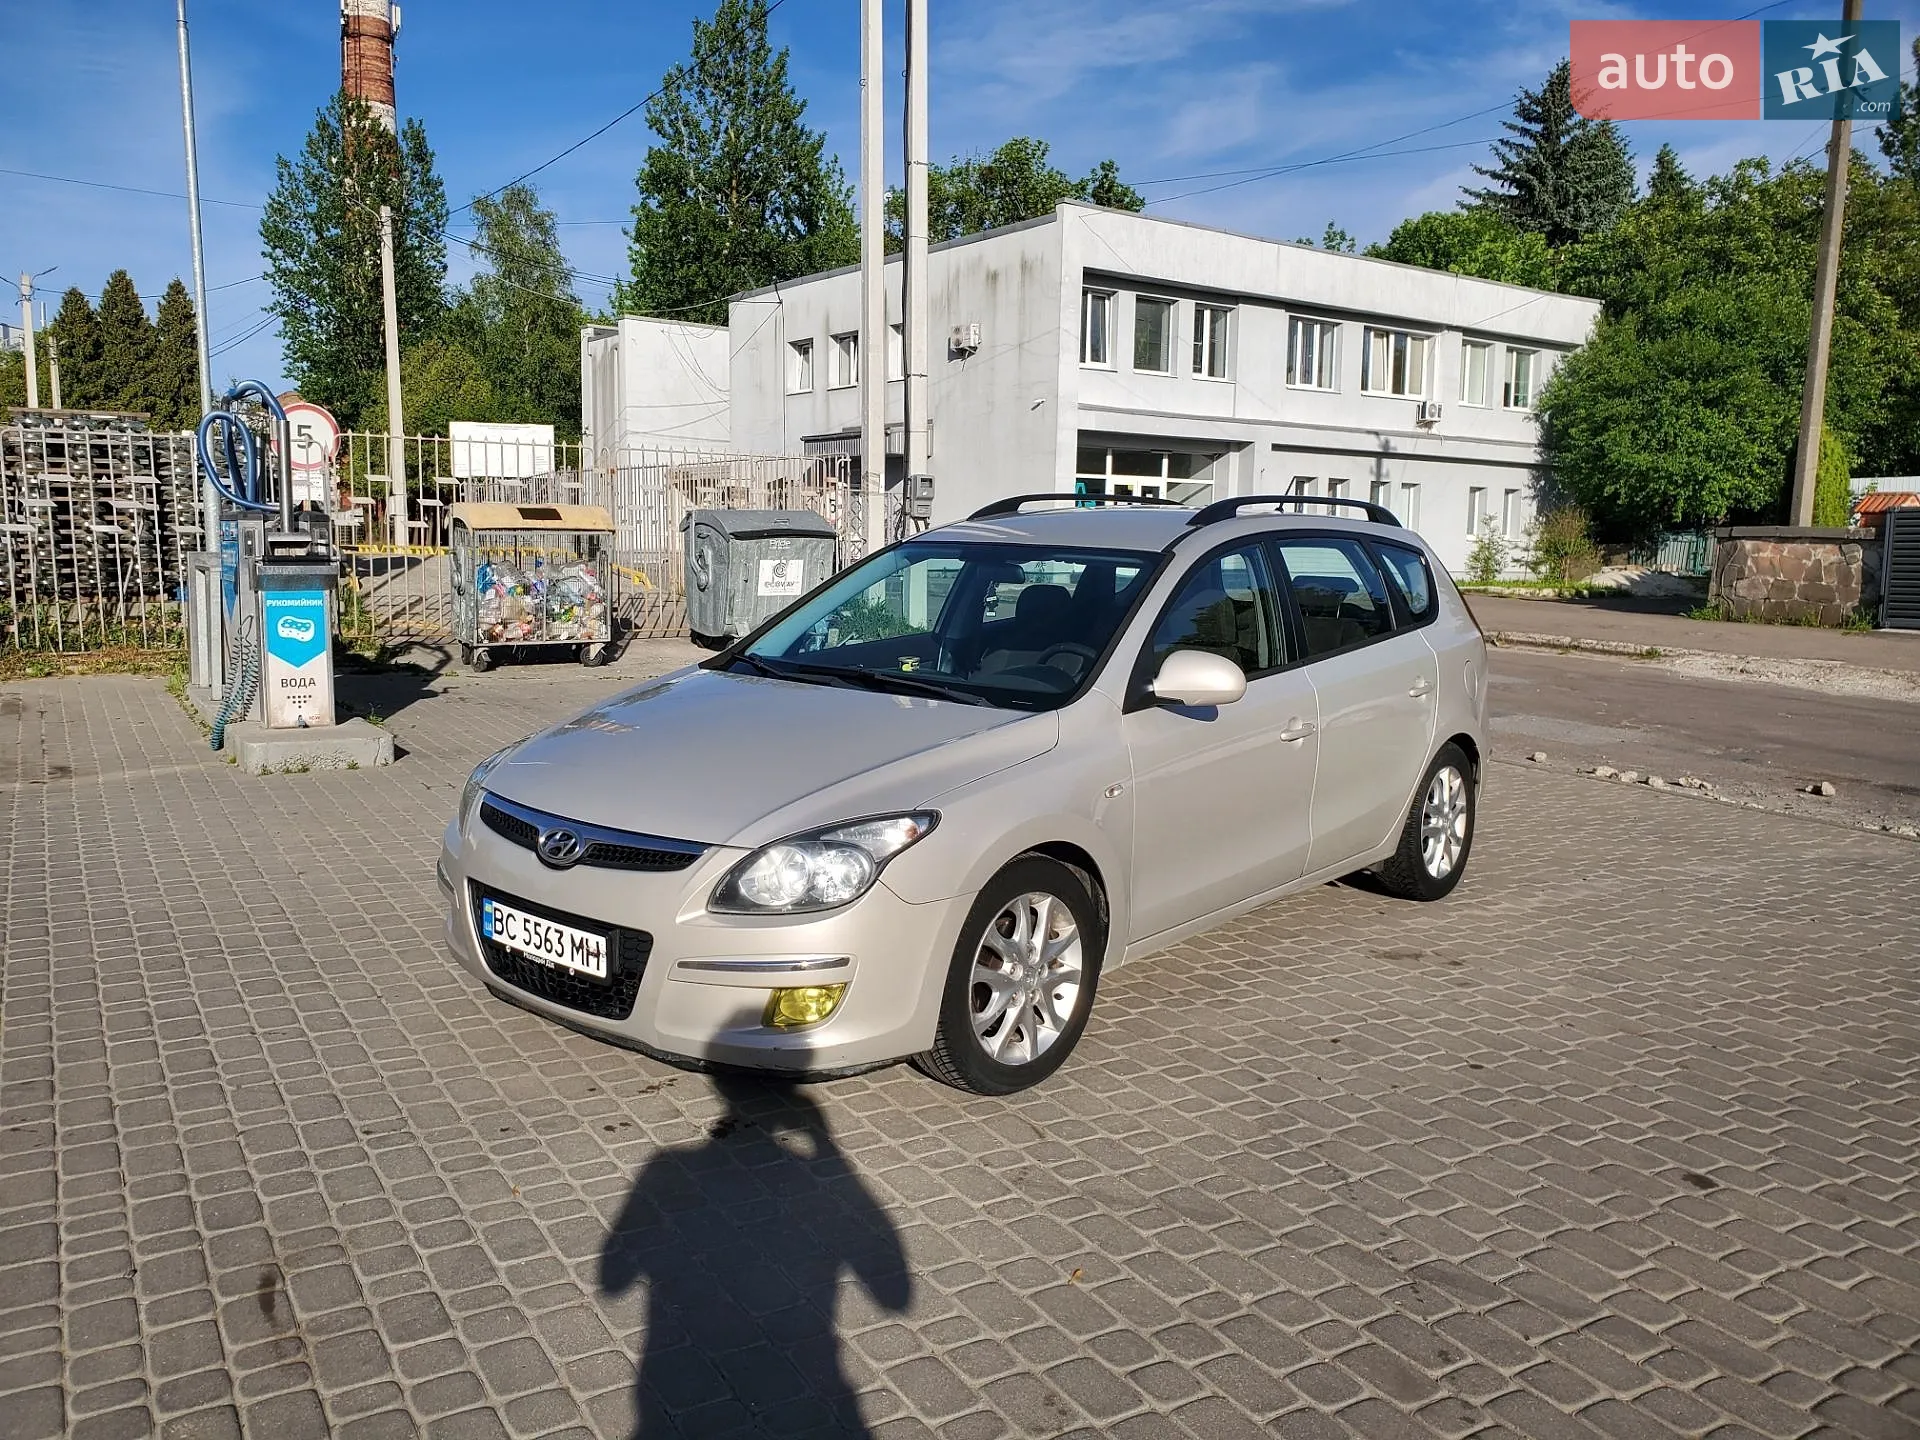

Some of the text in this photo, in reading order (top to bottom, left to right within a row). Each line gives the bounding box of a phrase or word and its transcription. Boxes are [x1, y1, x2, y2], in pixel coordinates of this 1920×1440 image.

[297, 424, 313, 449] 5
[266, 598, 324, 607] РУКОМИЙНИК
[280, 678, 316, 688] ВОДА
[493, 907, 517, 940] BC
[522, 917, 565, 958] 5563
[570, 933, 601, 971] MH
